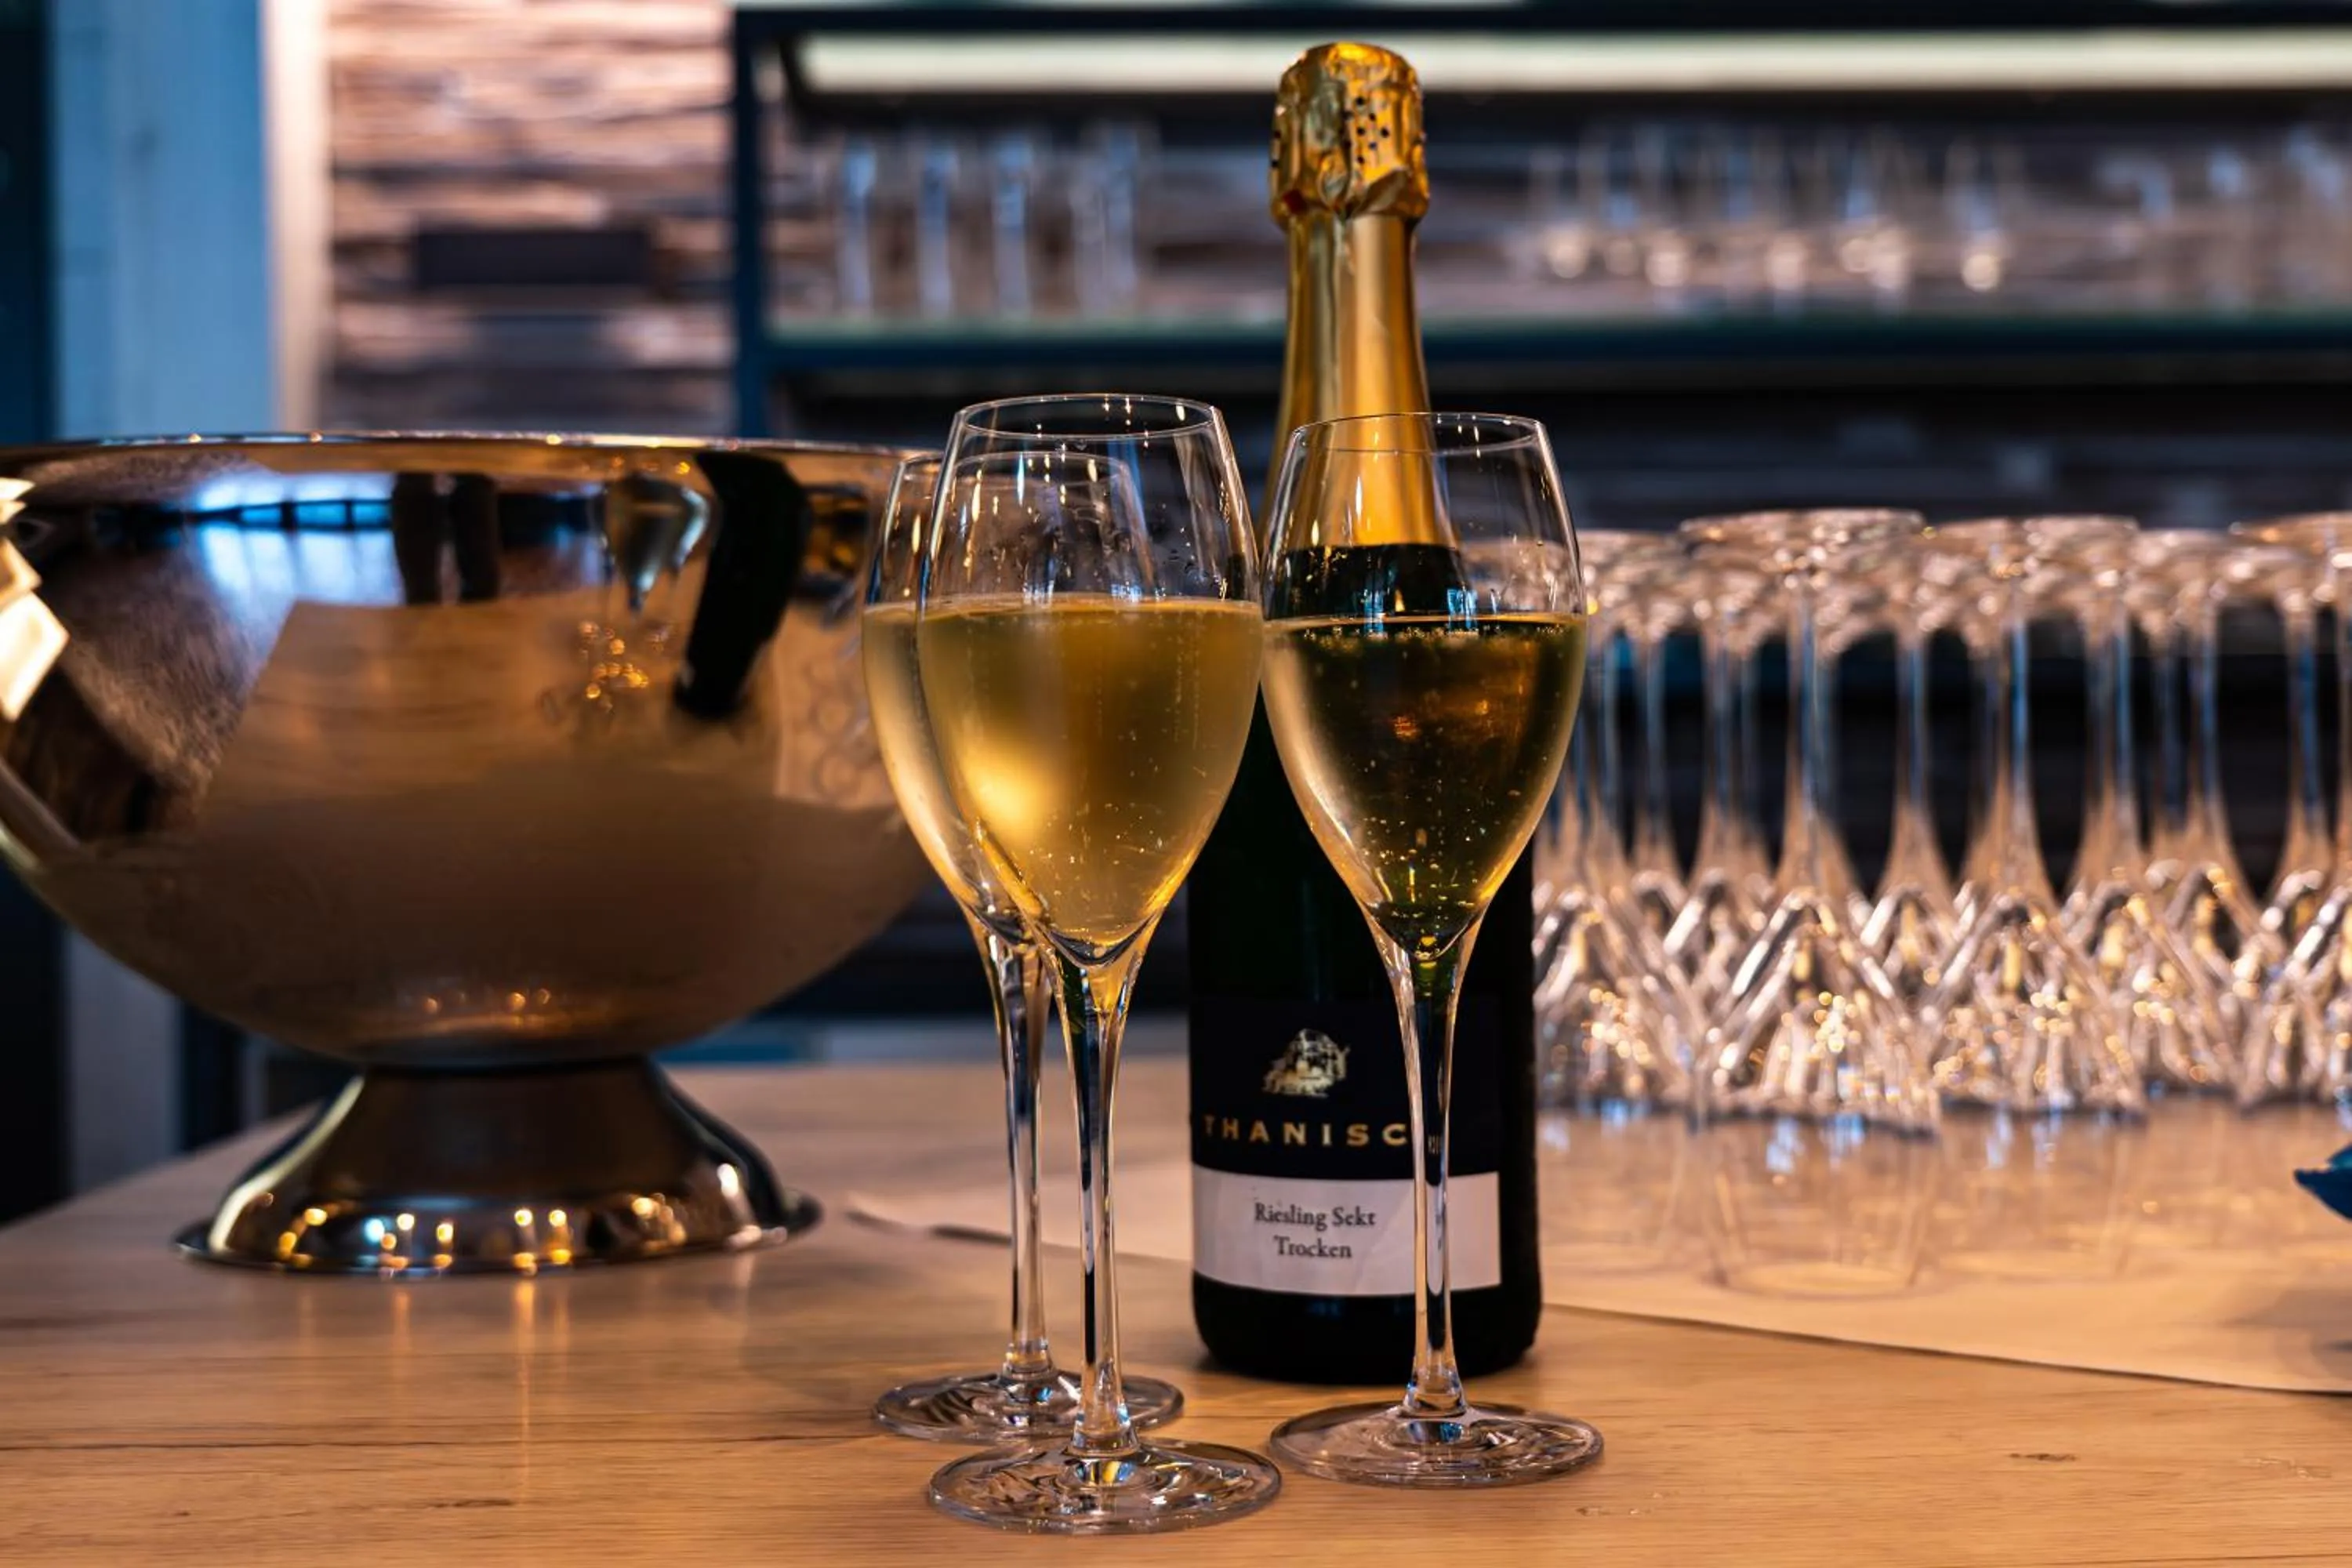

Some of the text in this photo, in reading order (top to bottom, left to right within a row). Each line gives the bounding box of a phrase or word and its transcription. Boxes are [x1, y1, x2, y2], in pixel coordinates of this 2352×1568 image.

[1203, 1114, 1440, 1152] THANISC
[1254, 1202, 1376, 1232] Riesling Sekt
[1273, 1235, 1352, 1258] Trocken
